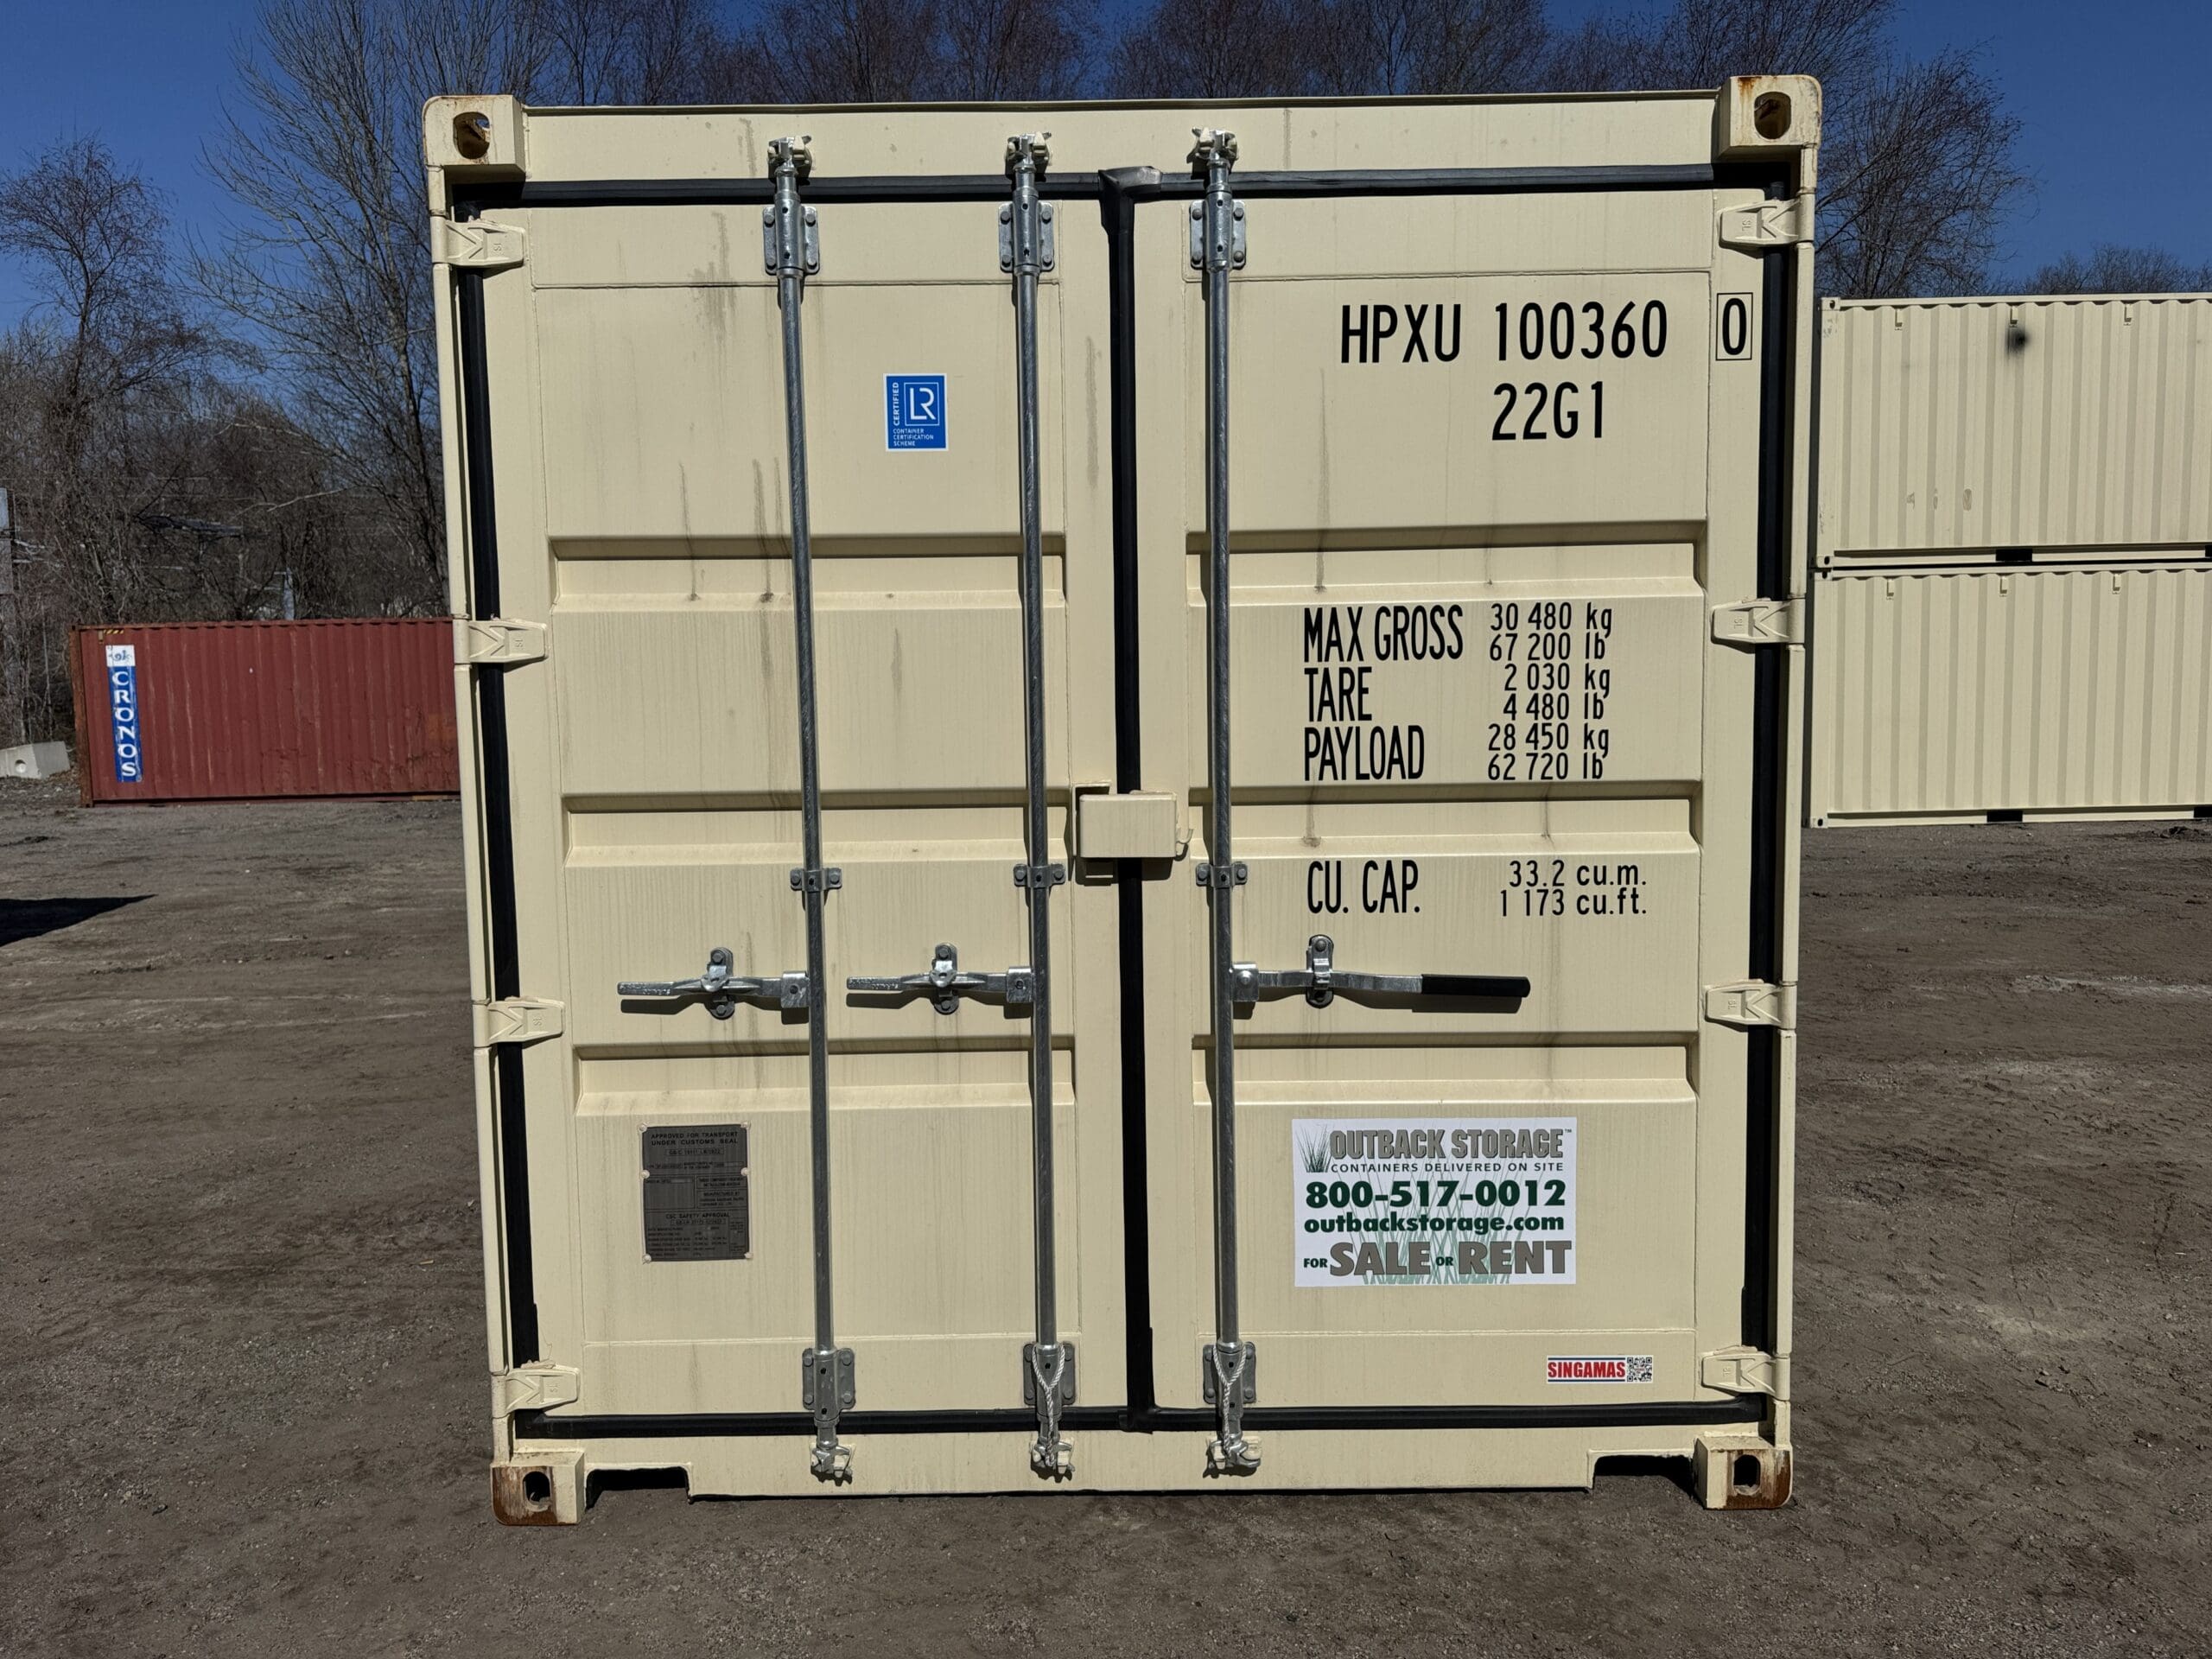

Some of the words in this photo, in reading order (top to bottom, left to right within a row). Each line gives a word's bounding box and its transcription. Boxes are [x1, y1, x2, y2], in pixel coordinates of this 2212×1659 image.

[1341, 303, 1461, 364] HPXU
[1495, 300, 1668, 361] 100360
[1723, 298, 1747, 356] 0
[892, 382, 900, 426] CERTIFIED
[909, 387, 937, 420] LR
[1491, 380, 1603, 441] 22G1
[1304, 606, 1364, 663] MAX
[1374, 604, 1464, 661] GROSS
[1490, 602, 1519, 631] 30
[1528, 601, 1572, 631] 480
[1586, 601, 1612, 639] kg
[1490, 632, 1518, 661] 67
[1527, 632, 1571, 661] 200
[1585, 632, 1605, 660] lb
[1304, 666, 1372, 722] TARE
[1504, 663, 1517, 691] 2
[1527, 663, 1570, 691] 030
[1584, 663, 1611, 699] kg
[1503, 693, 1517, 721] 4
[1525, 692, 1570, 721] 480
[1584, 692, 1605, 720] lb
[111, 671, 137, 777] CRONOS
[1304, 725, 1425, 782] PAYLOAD
[1488, 722, 1516, 751] 28
[1525, 722, 1569, 751] 450
[1583, 722, 1610, 759] kg
[1488, 753, 1516, 781] 62
[1525, 752, 1569, 780] 720
[1583, 752, 1604, 779] lb
[1307, 860, 1349, 914] CU.
[1362, 859, 1421, 913] CAP.
[1509, 859, 1565, 887] 33.2
[1576, 864, 1647, 887] cu.m.
[1500, 889, 1507, 917] 1
[1523, 888, 1565, 917] 173
[1576, 887, 1647, 915] cu.ft.
[1329, 1129, 1447, 1160] OUTBACK
[1451, 1128, 1564, 1159] STORAGE
[1331, 1163, 1419, 1173] CONTAINERS
[1425, 1162, 1502, 1173] DELIVERED
[1507, 1162, 1528, 1172] ON
[1534, 1162, 1564, 1172] SITE
[1306, 1179, 1567, 1209] 800-517-0012
[1304, 1211, 1565, 1236] outbackstorage.com
[1303, 1257, 1328, 1268] FOR
[1330, 1242, 1431, 1277] SALE
[1435, 1255, 1454, 1267] OR
[1458, 1240, 1573, 1275] RENT
[1548, 1362, 1626, 1378] SINGAMAS
